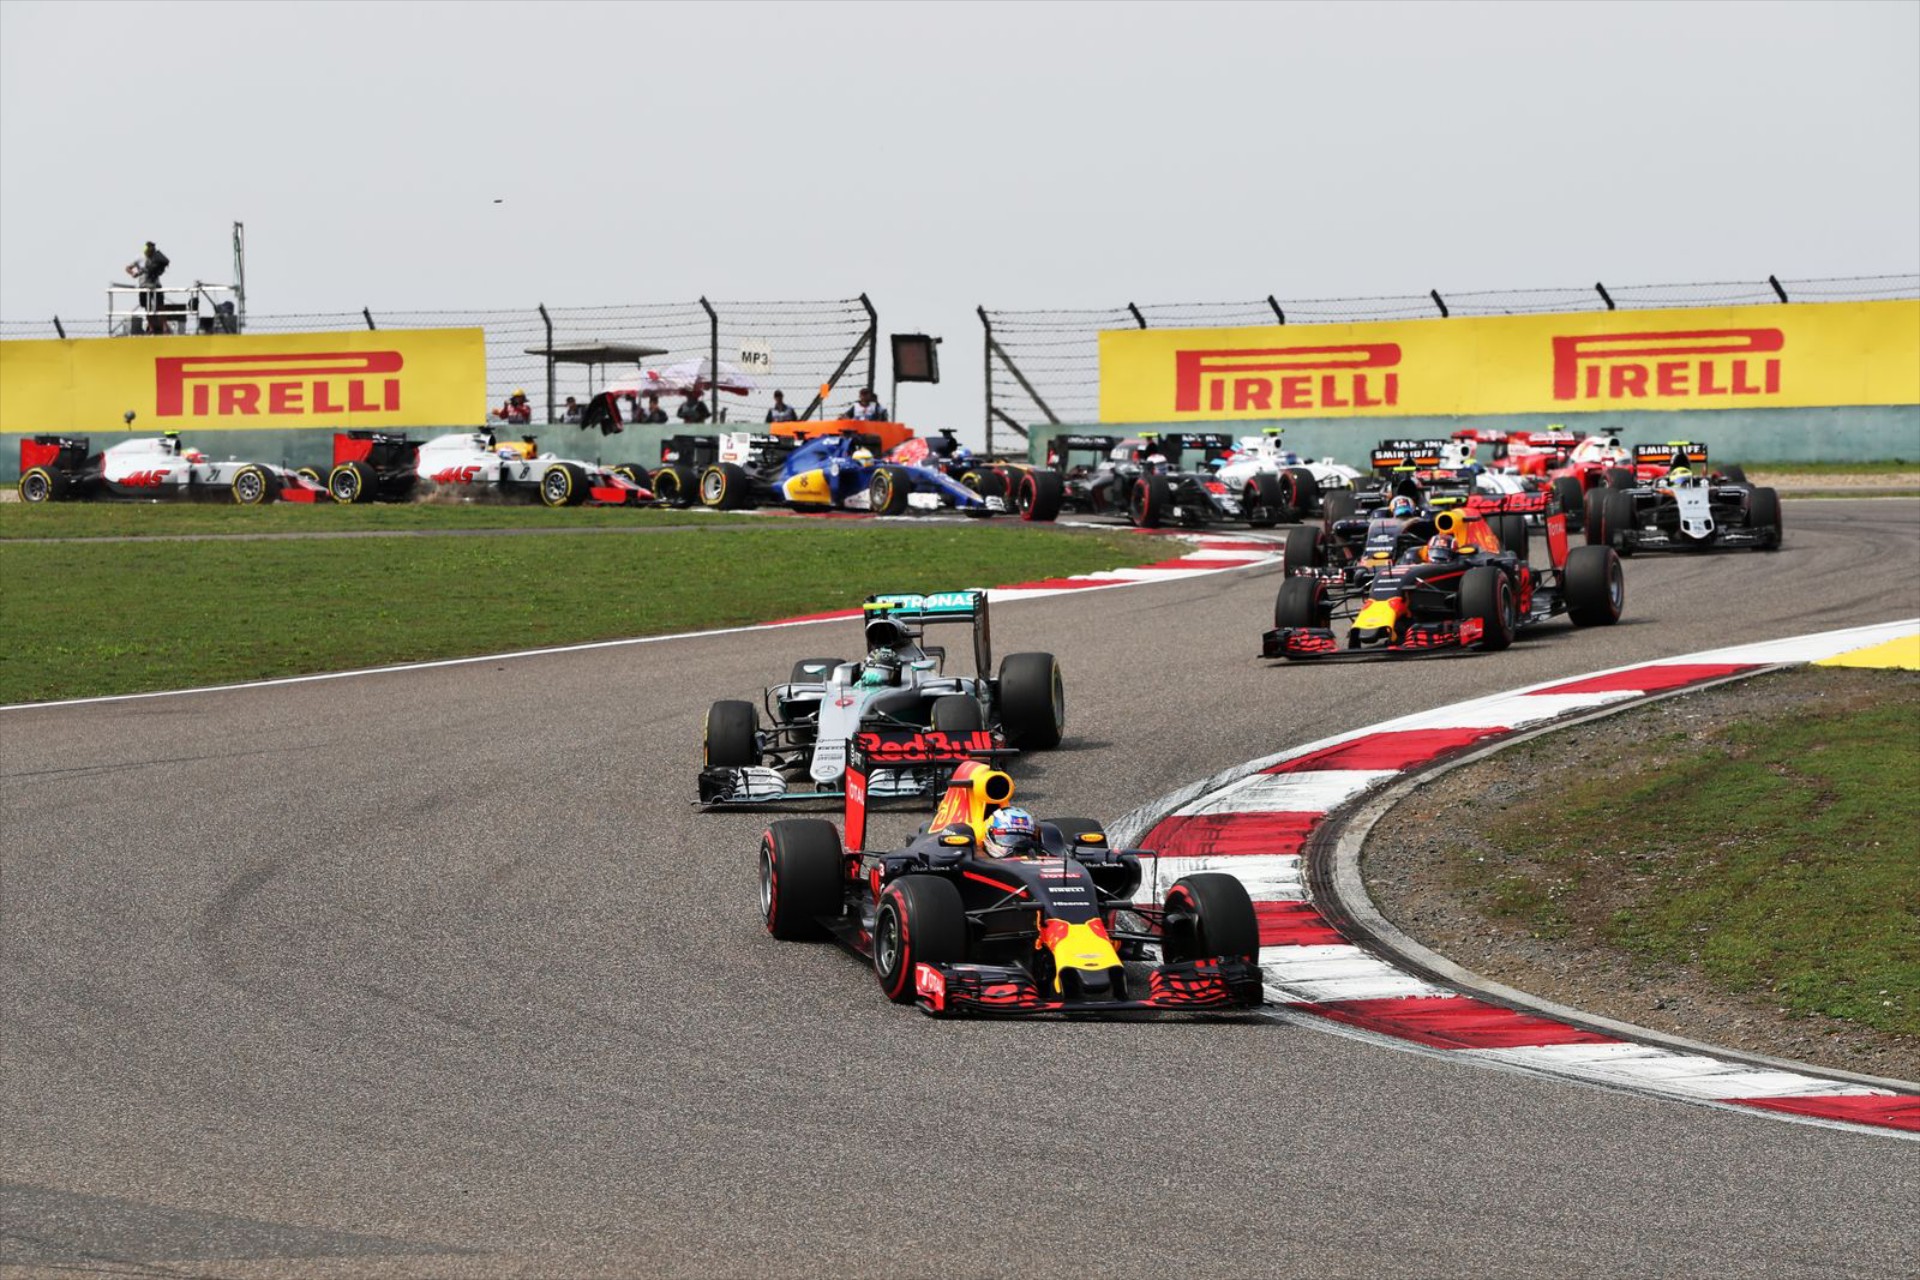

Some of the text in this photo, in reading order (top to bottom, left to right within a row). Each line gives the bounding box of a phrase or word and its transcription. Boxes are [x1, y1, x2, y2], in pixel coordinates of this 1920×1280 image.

[156, 351, 403, 417] PIRELLI
[742, 351, 768, 365] MP3
[1175, 343, 1402, 412] PIRELLI
[1552, 328, 1784, 400] PIRELLI
[1638, 445, 1701, 455] SMIRNFF
